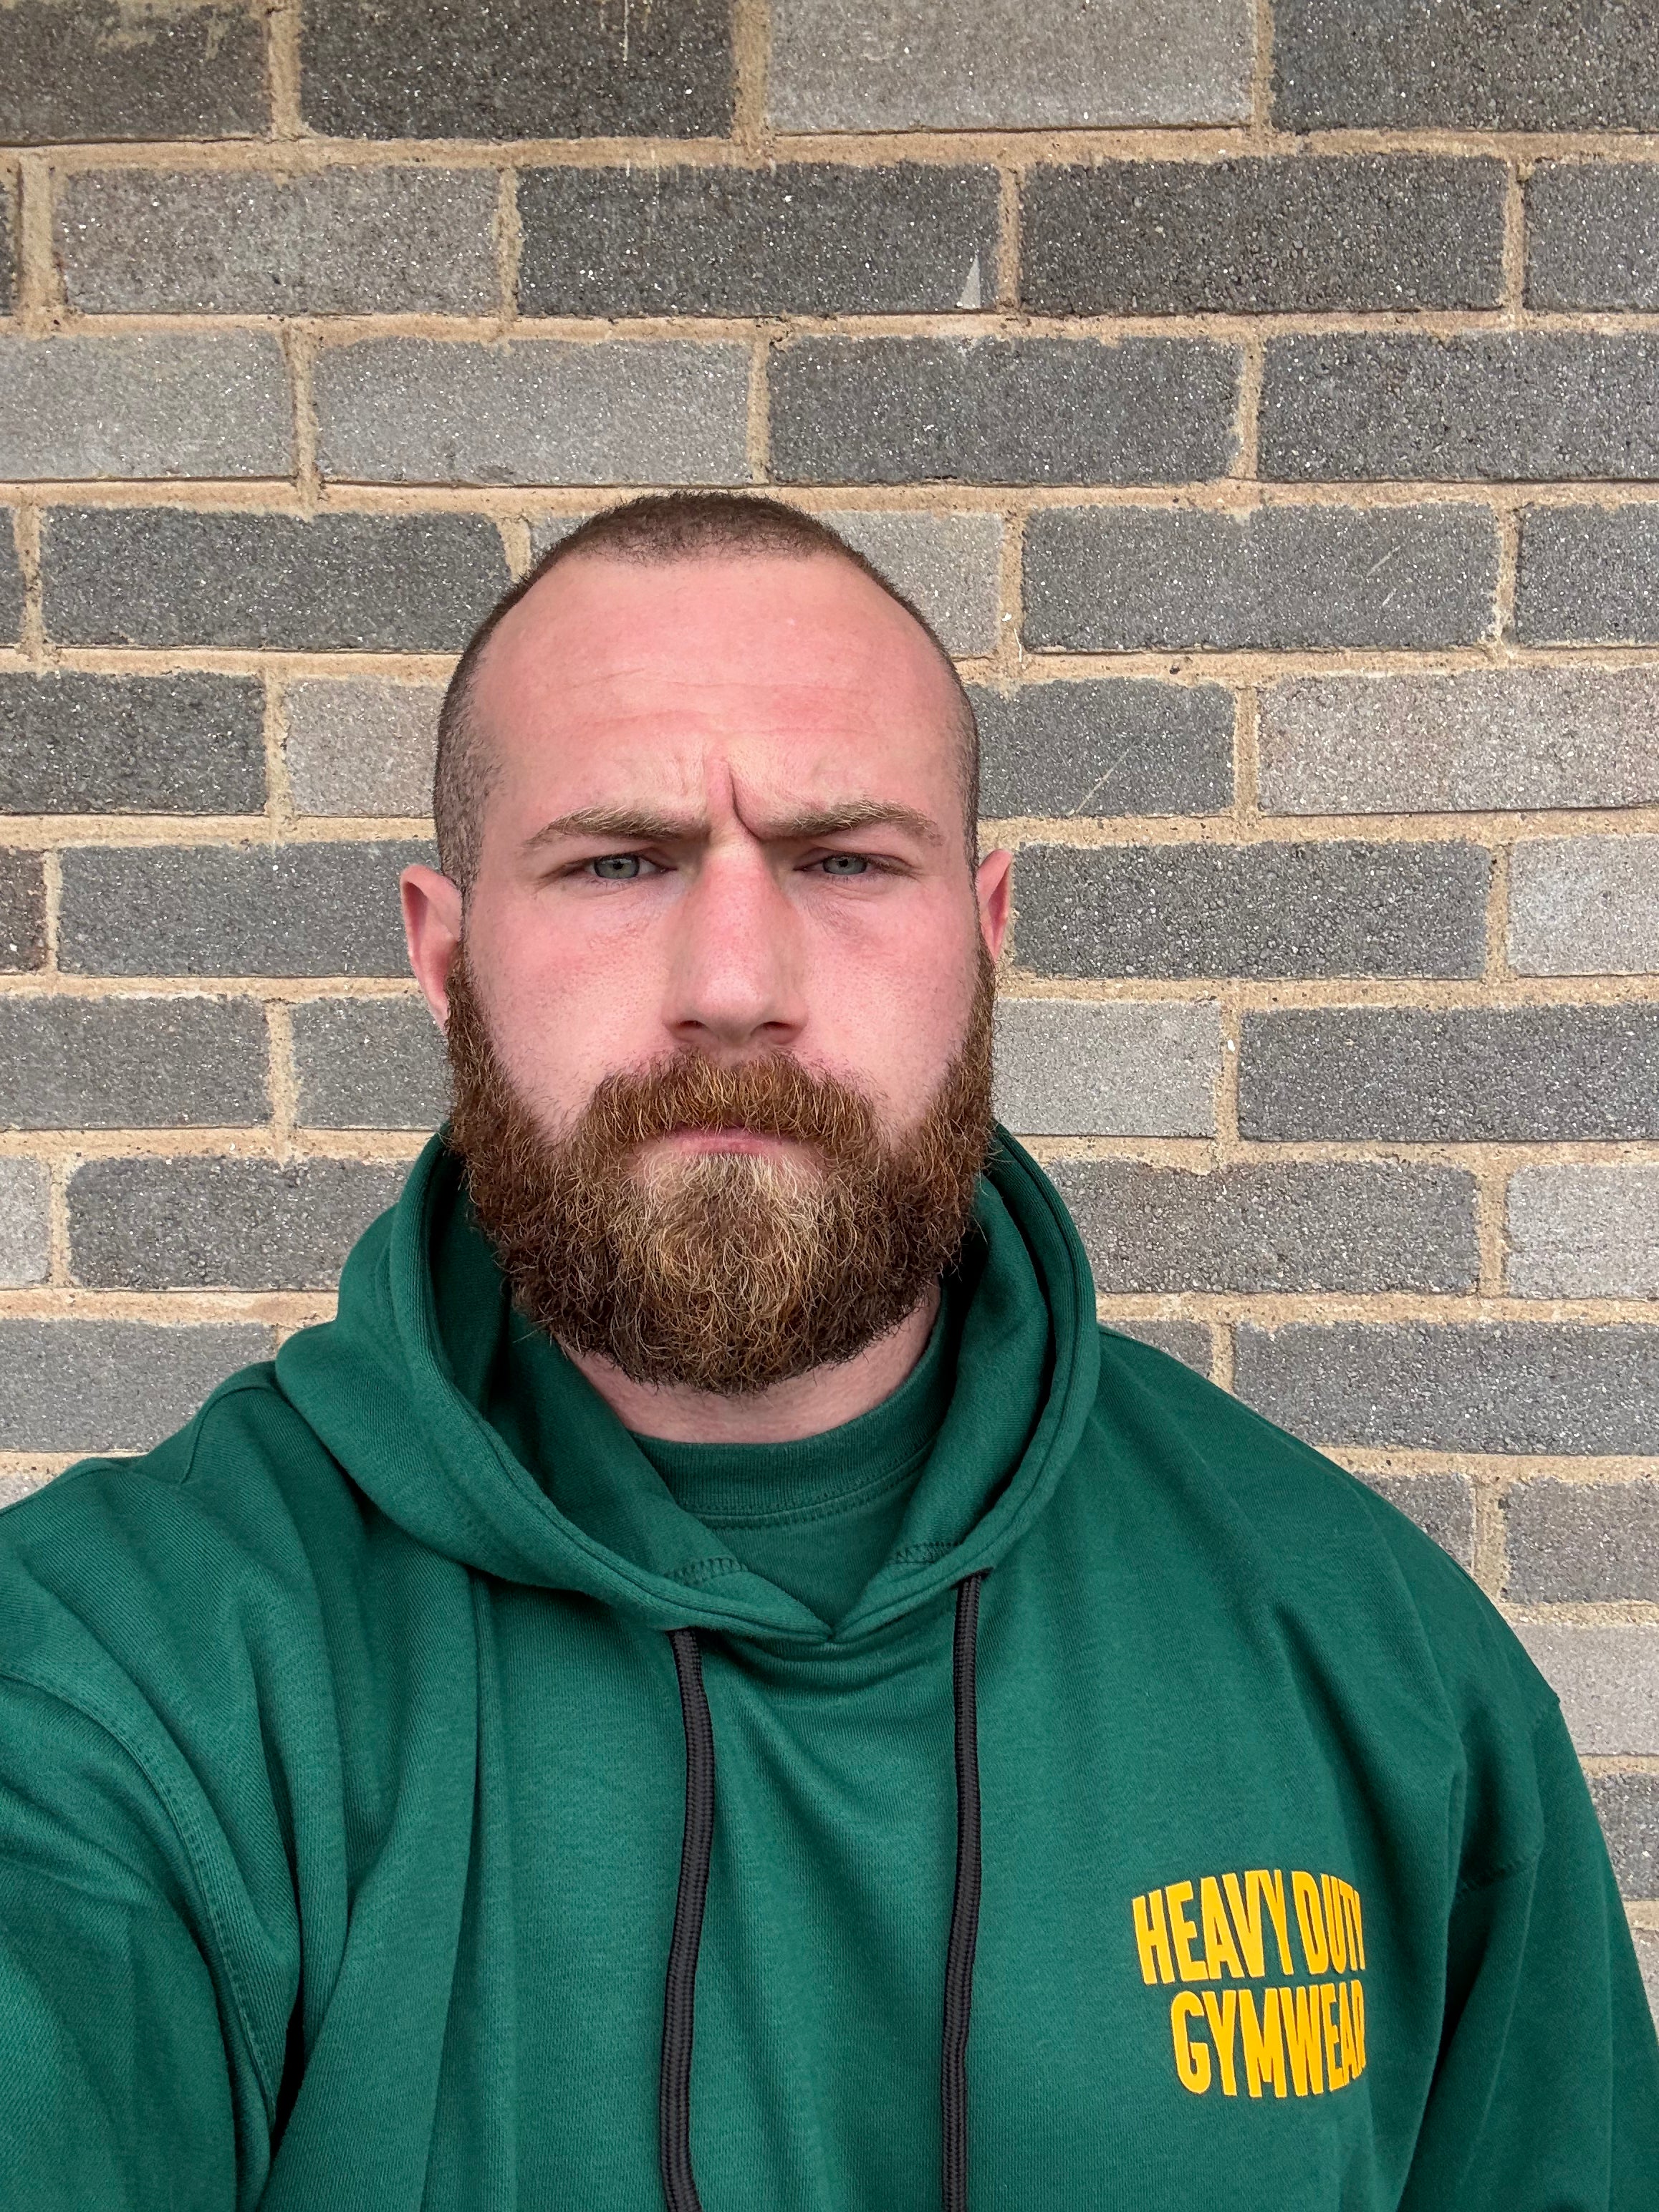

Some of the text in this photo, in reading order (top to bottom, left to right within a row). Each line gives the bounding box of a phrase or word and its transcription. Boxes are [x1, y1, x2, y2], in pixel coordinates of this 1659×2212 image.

[1133, 1870, 1365, 1985] HEAVY DUTY
[1170, 1980, 1366, 2098] GYMWEAR
